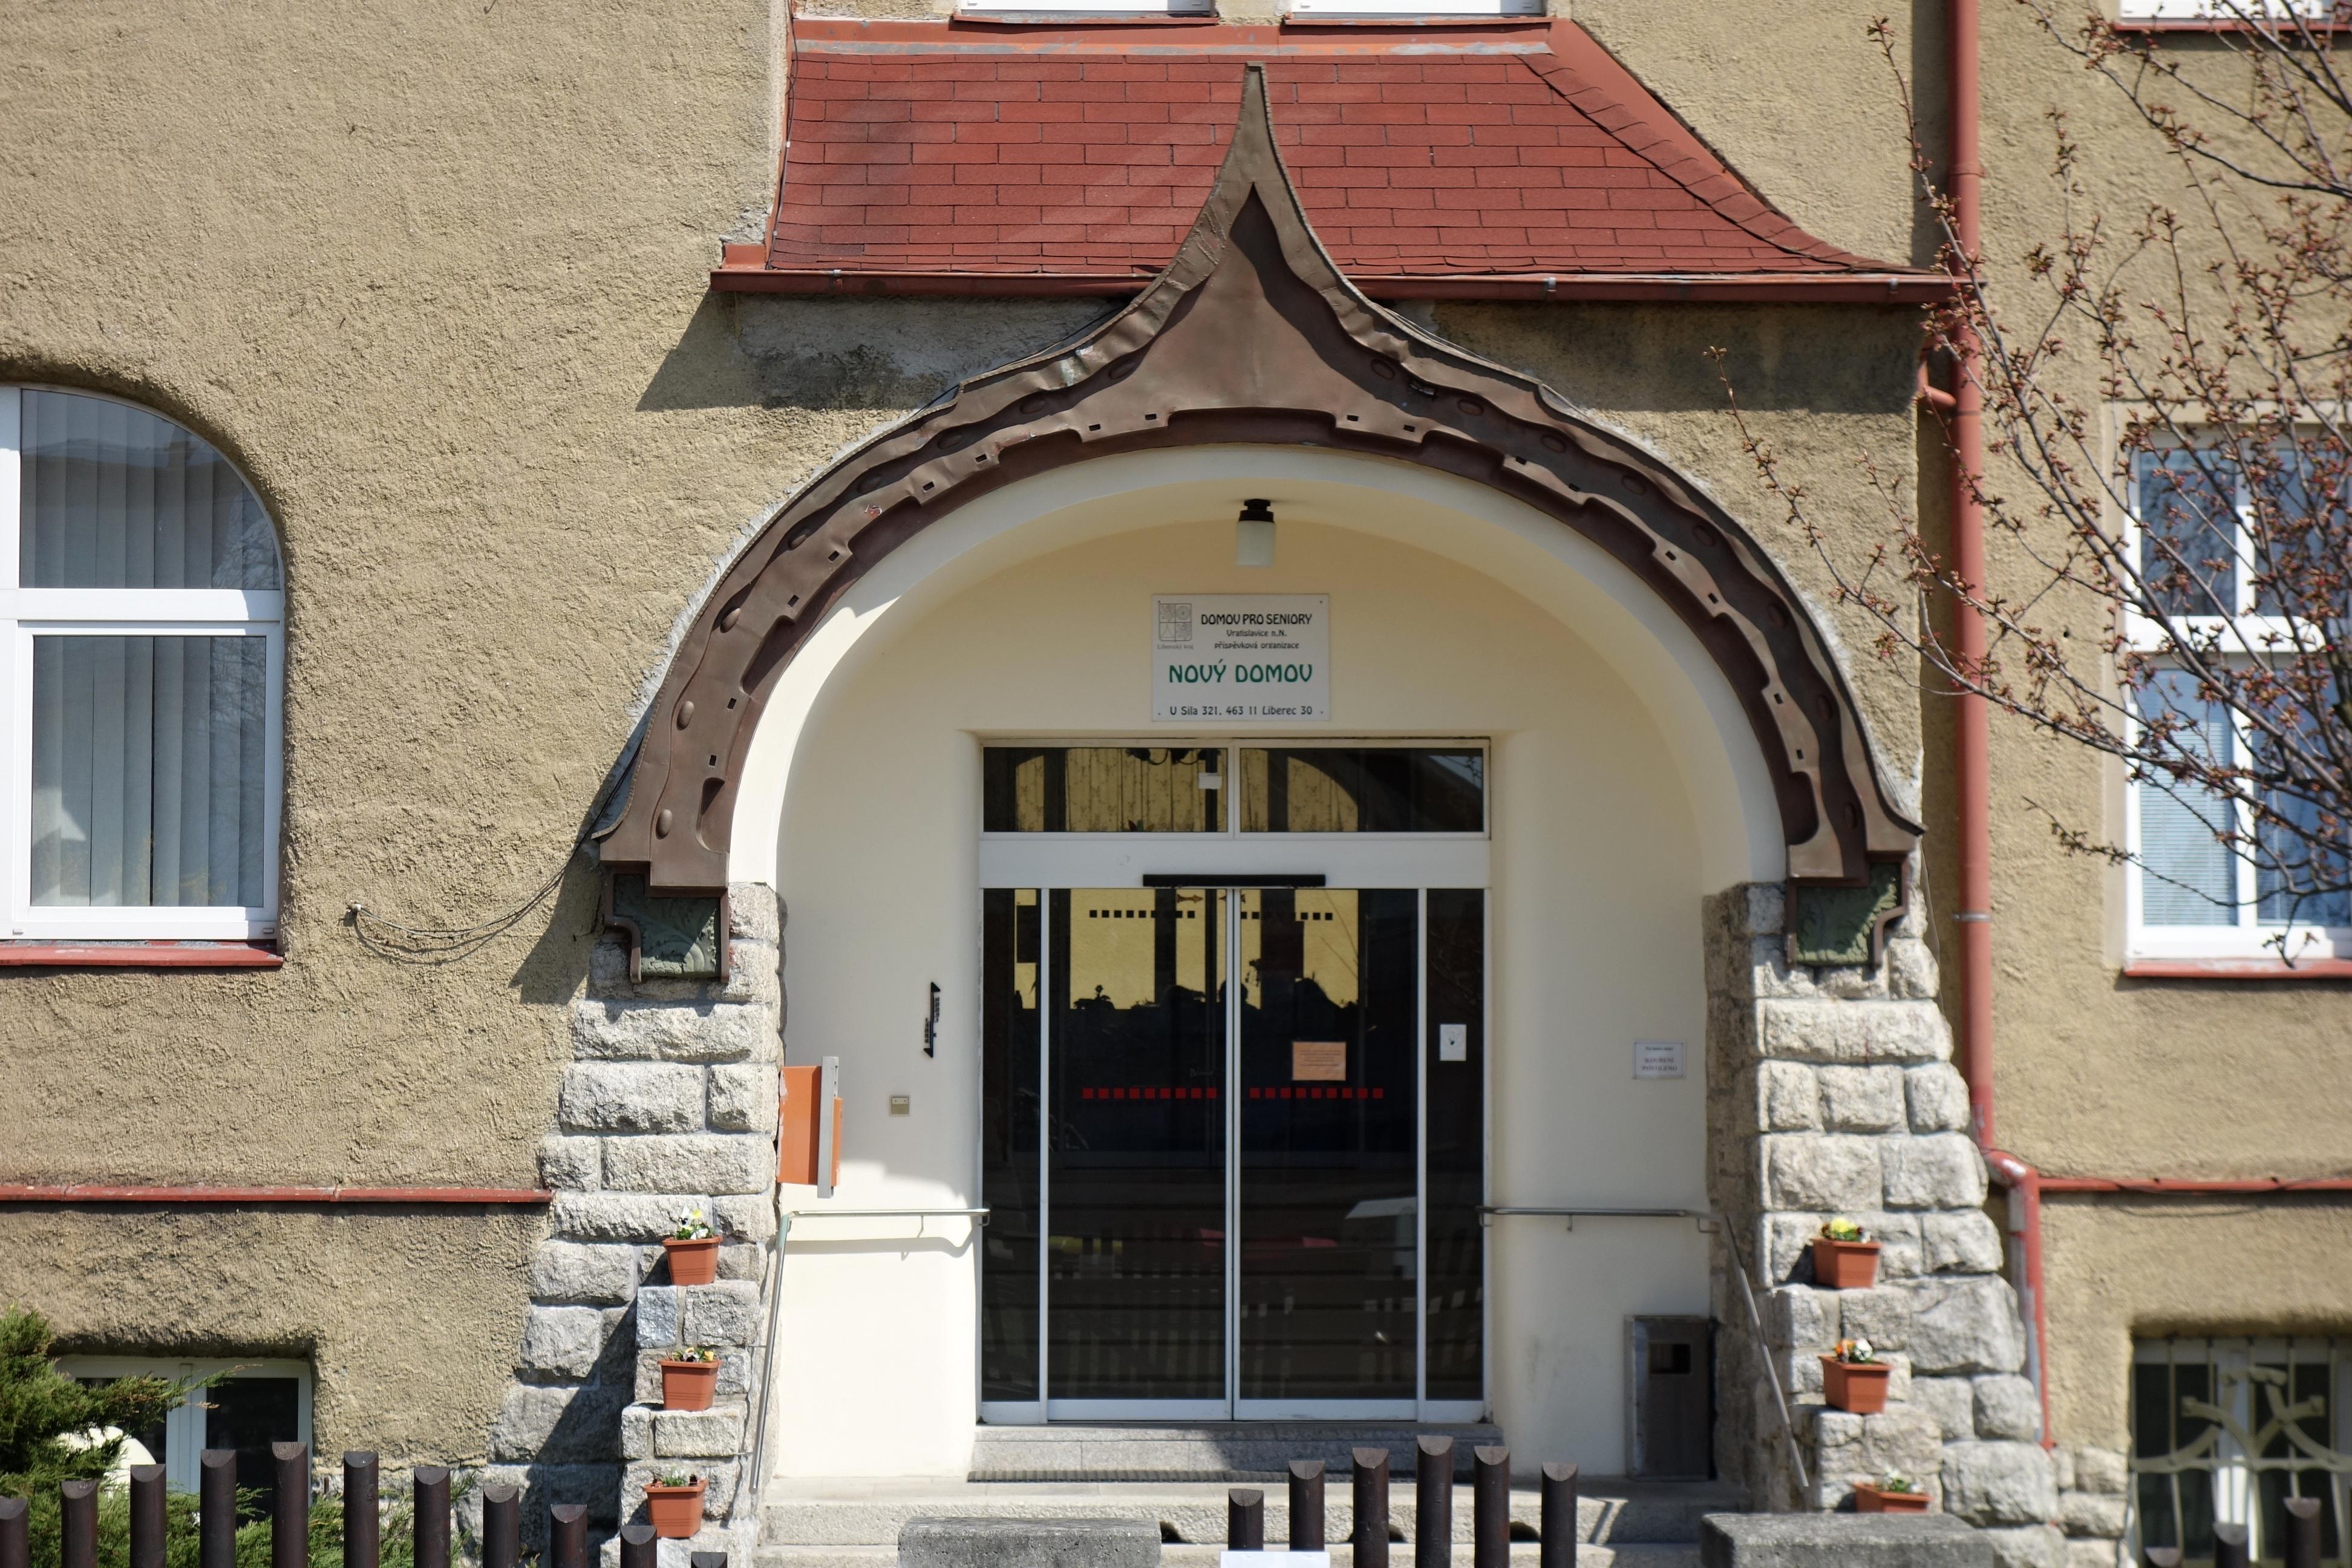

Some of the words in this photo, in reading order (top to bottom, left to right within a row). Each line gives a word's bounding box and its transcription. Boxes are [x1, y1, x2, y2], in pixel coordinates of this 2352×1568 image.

[1201, 613, 1240, 625] DOMOV
[1243, 613, 1264, 625] PRO
[1266, 613, 1312, 625] SENIORY
[1214, 641, 1258, 649] příspěvková
[1169, 659, 1227, 683] NOVÝ
[1235, 664, 1313, 683] DOMOV
[1169, 706, 1177, 715] U
[1226, 706, 1244, 715] 463
[1249, 706, 1257, 715] 11
[1262, 705, 1296, 715] Liberec
[1300, 705, 1313, 715] 30
